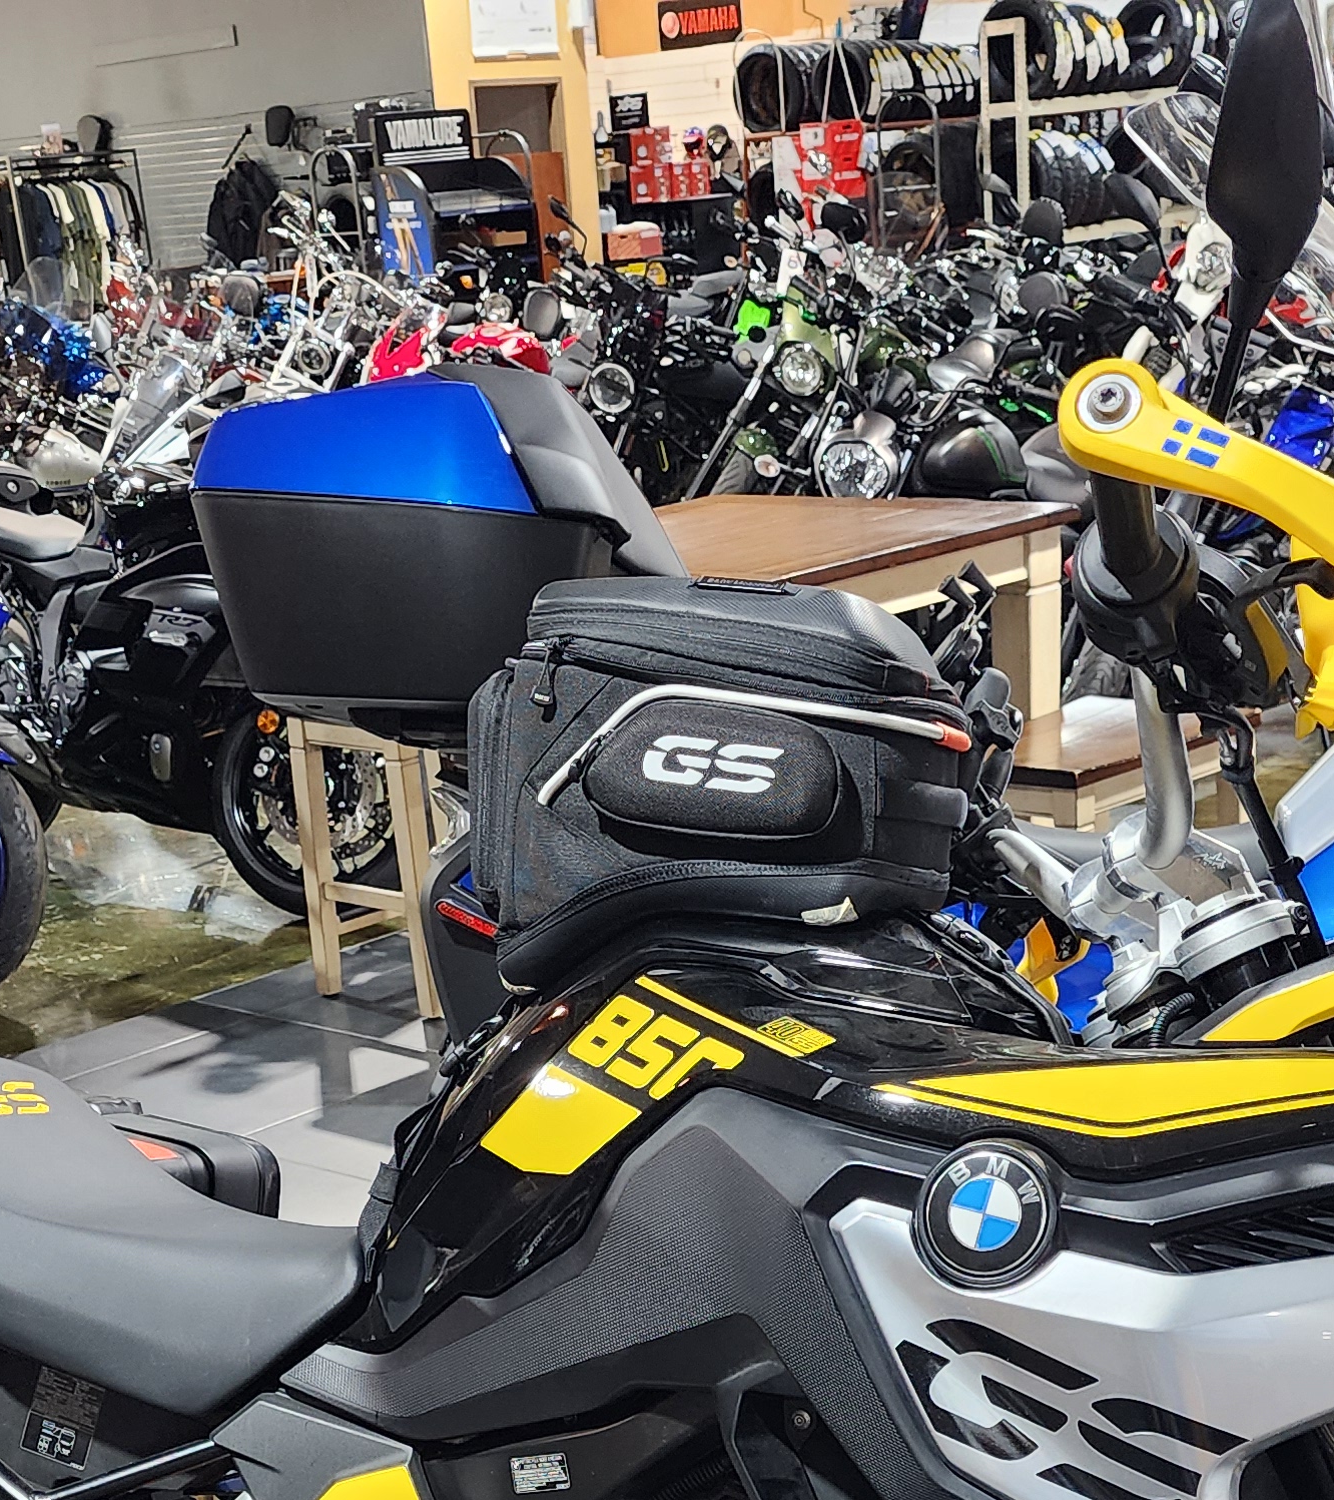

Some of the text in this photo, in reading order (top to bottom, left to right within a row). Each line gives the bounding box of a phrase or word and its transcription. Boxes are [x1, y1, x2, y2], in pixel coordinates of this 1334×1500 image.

[678, 5, 739, 35] YAMAHA
[384, 116, 464, 150] YAMALUBE
[642, 735, 785, 794] GS
[947, 1154, 1042, 1207] BMW
